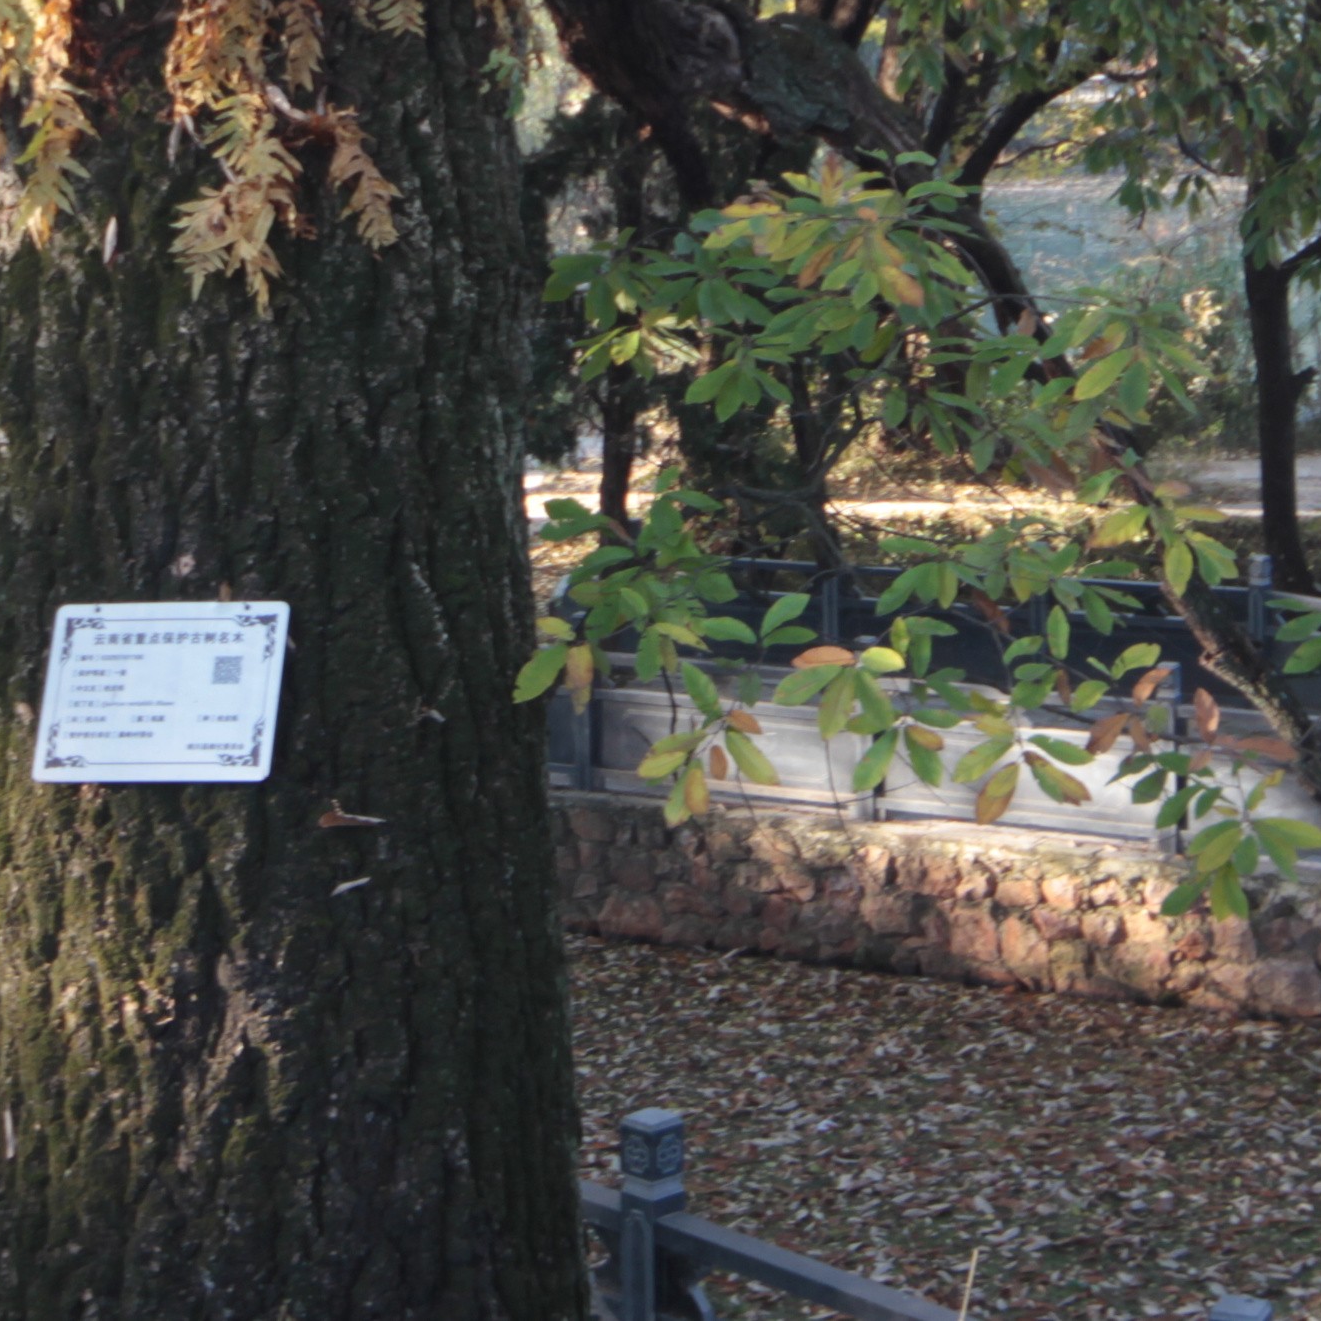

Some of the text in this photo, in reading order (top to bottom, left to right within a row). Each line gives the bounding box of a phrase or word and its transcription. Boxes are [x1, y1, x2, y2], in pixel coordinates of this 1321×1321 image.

[94, 631, 245, 646] 云南省重点保护古树名木
